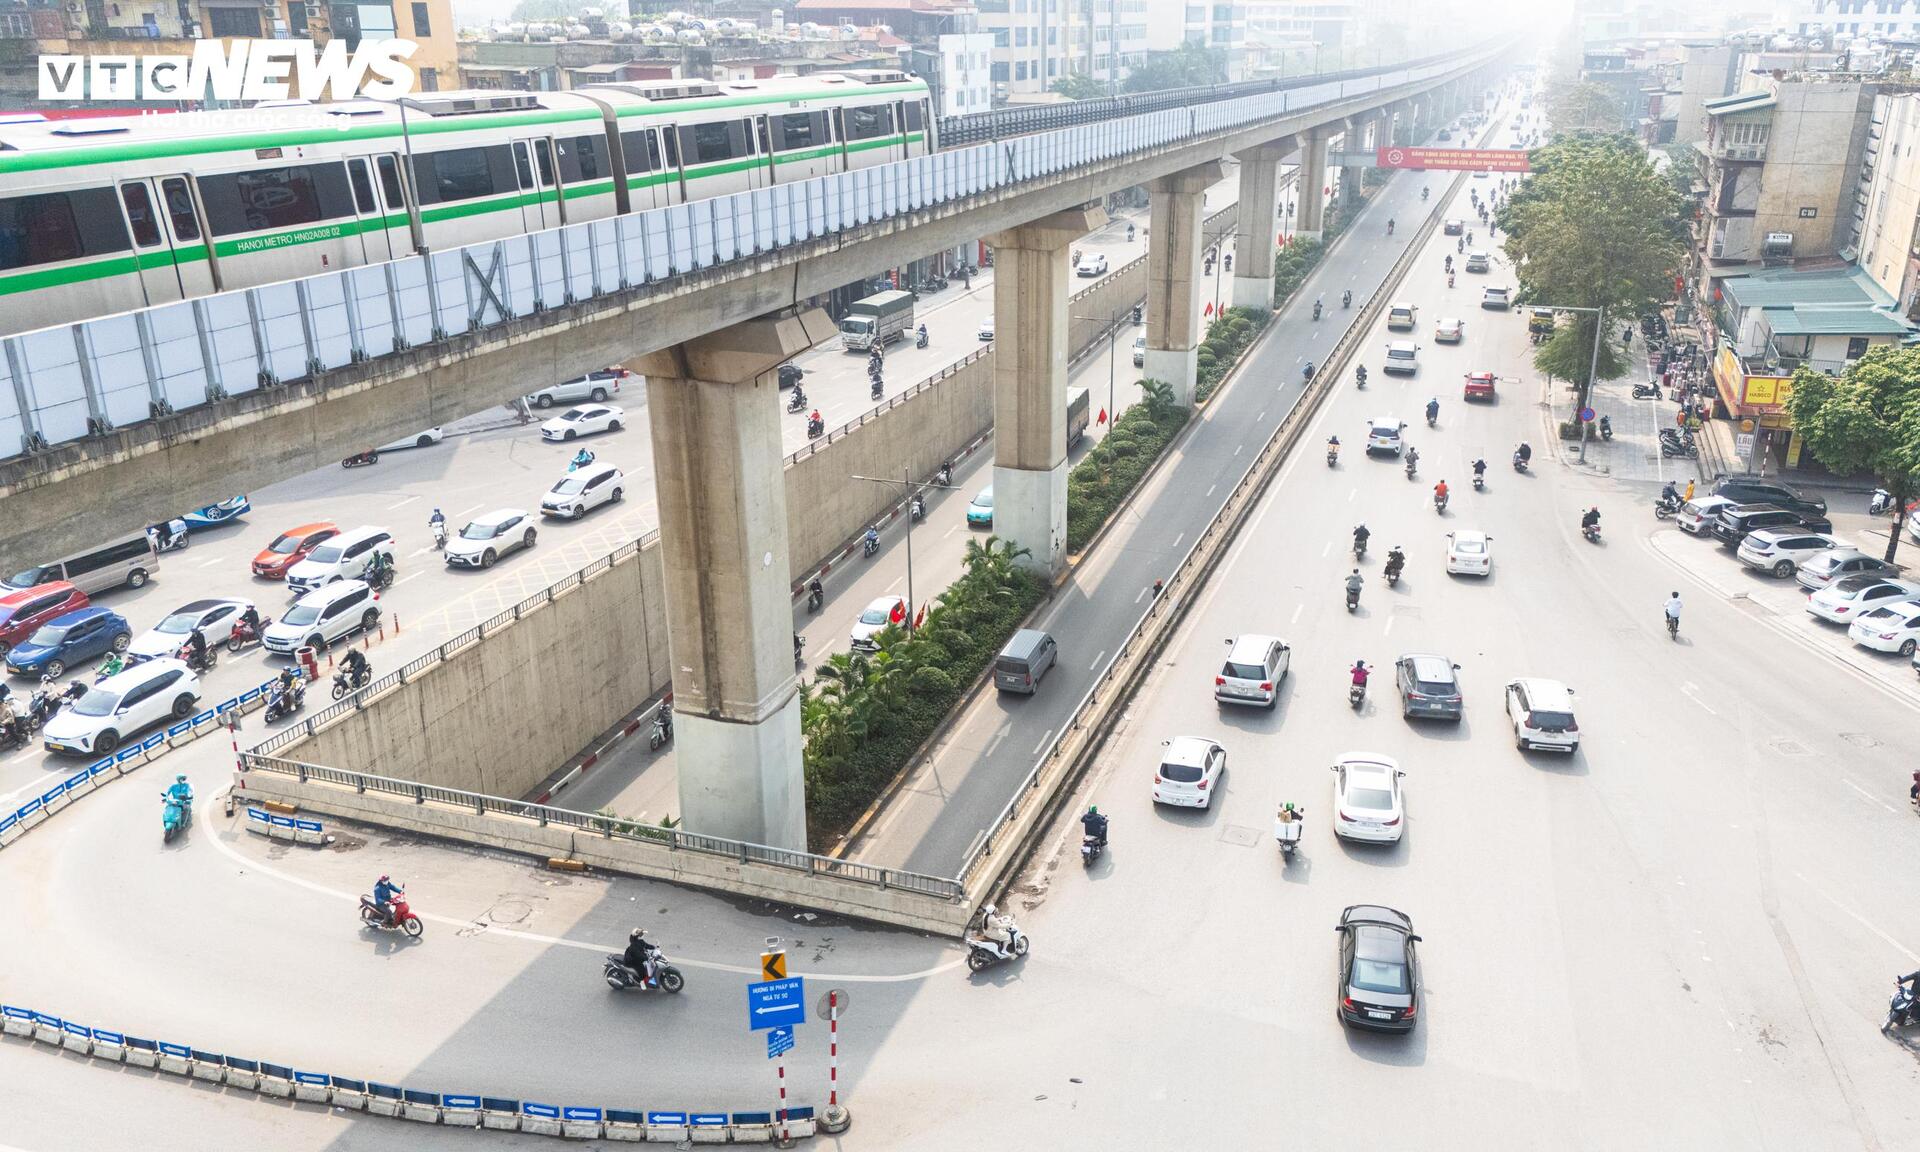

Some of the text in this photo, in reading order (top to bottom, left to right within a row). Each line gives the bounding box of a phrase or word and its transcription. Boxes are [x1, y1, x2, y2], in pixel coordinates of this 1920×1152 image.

[237, 239, 264, 251] HANOI
[265, 235, 293, 247] METRO
[331, 227, 341, 236] 02
